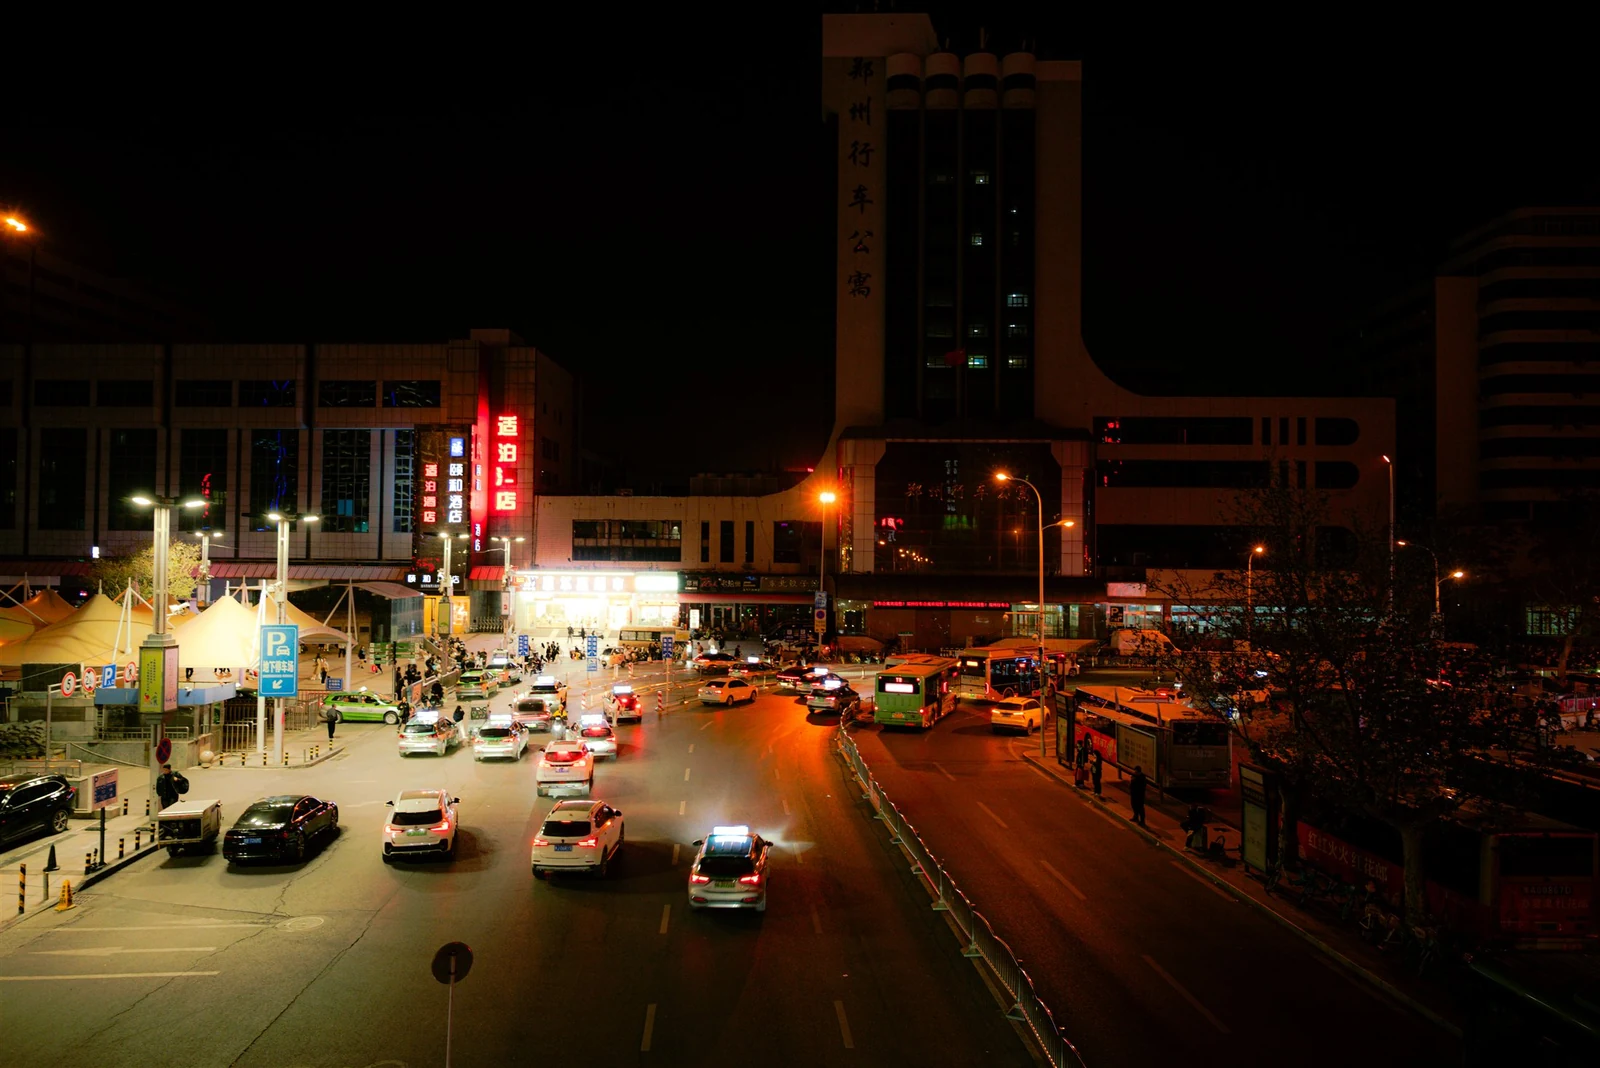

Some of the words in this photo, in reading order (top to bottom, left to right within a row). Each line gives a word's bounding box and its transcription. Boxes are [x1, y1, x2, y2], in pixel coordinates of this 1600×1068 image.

[848, 57, 874, 299] 郑州行车公寓
[424, 464, 438, 523] 适泊酒店
[448, 463, 463, 523] 颐和酒店
[267, 632, 286, 656] P
[104, 667, 113, 686] P
